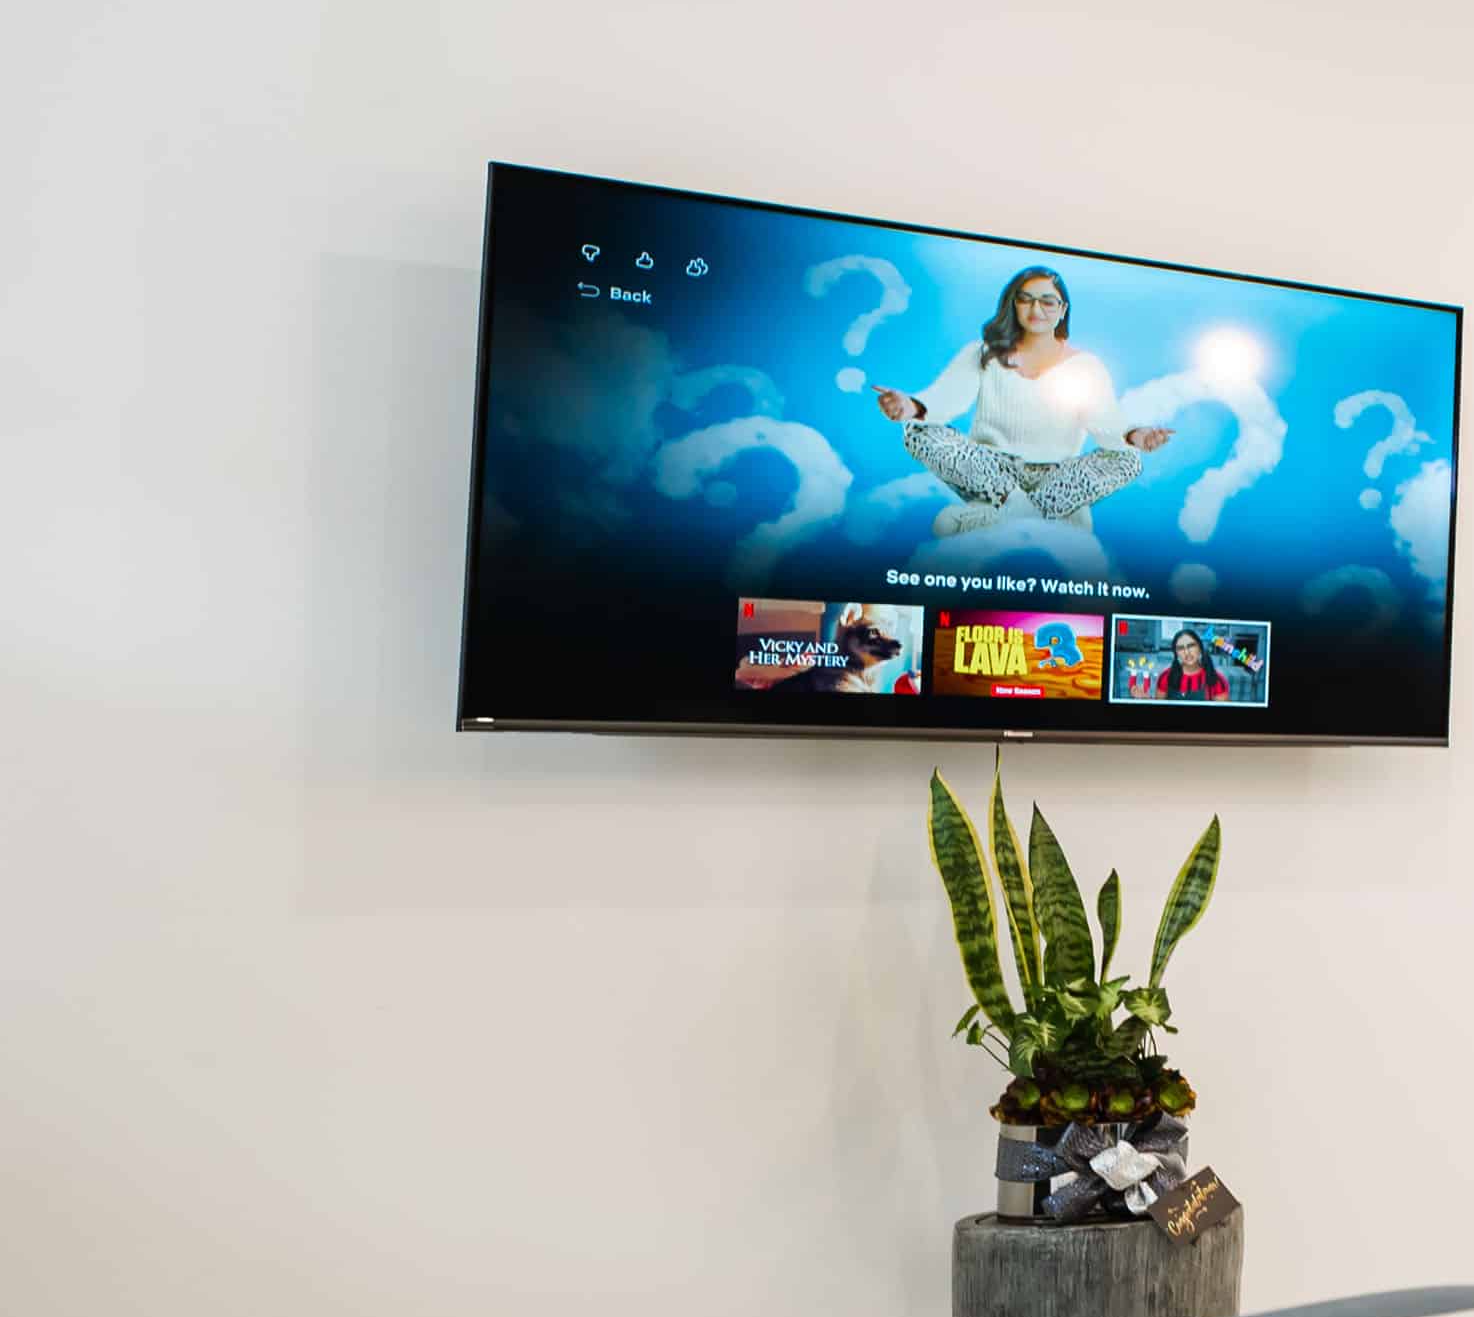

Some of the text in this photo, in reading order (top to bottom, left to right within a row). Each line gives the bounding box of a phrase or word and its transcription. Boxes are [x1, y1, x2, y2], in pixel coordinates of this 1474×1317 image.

[610, 286, 652, 304] Back
[886, 569, 1150, 600] See one you like? Watch it now.
[956, 625, 1025, 646] FLOOR IS
[953, 641, 1028, 676] LAVA
